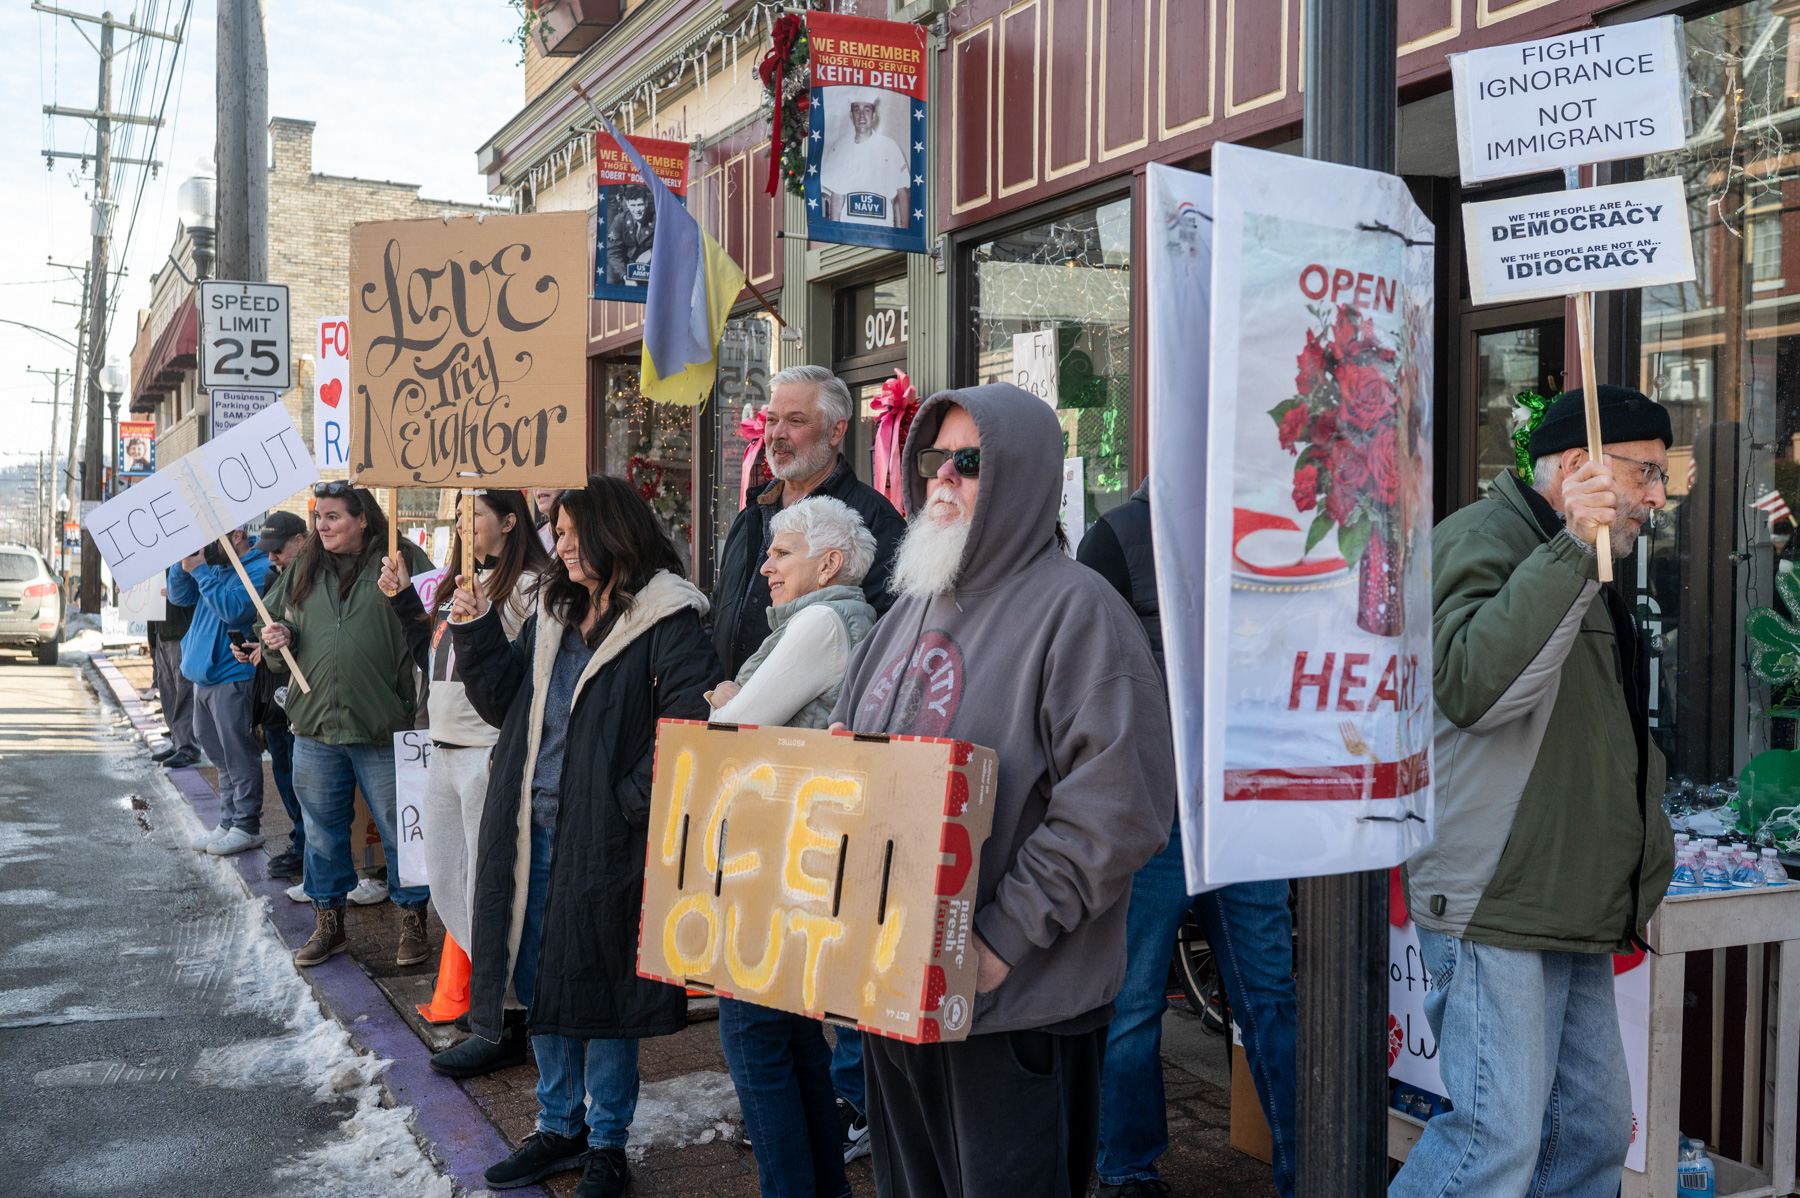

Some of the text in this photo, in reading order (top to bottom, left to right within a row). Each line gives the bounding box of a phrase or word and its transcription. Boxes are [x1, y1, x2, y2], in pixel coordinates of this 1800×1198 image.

[812, 36, 920, 63] WE REMEMBER
[1522, 34, 1605, 65] FIGHT
[816, 63, 917, 90] KEITH DEILY
[818, 54, 916, 74] THOSE WHO SERVED
[1479, 53, 1654, 100] IGNORANCE
[1538, 98, 1597, 126] NOT
[1487, 118, 1655, 161] IMMIGRANTS
[600, 149, 617, 161] WE
[622, 152, 684, 170] REMBER
[604, 162, 628, 171] THOSE
[600, 170, 626, 181] ROBERT
[854, 202, 879, 212] NAVY
[861, 195, 873, 203] US
[1508, 200, 1642, 222] WE THE PEOPLE ARE A...
[1491, 205, 1663, 242] DEMOCRACY
[1500, 239, 1661, 264] WE THE PEOPLE ARE NOT AN...
[1507, 247, 1658, 280] IDIOCRACY
[211, 294, 280, 312] SPEED
[1299, 264, 1397, 314] OPEN
[219, 316, 271, 333] LIMIT
[865, 309, 895, 350] 902
[212, 338, 280, 377] 25
[215, 401, 270, 411] Parking Onl
[223, 392, 265, 401] Business
[98, 426, 297, 567] ICE OUT
[922, 647, 955, 718] CITY
[1287, 651, 1418, 712] HEART
[662, 750, 862, 899] ICE
[933, 900, 949, 959] farms
[945, 900, 960, 952] fresh
[955, 900, 970, 966] nature
[896, 1011, 910, 1021] ECT
